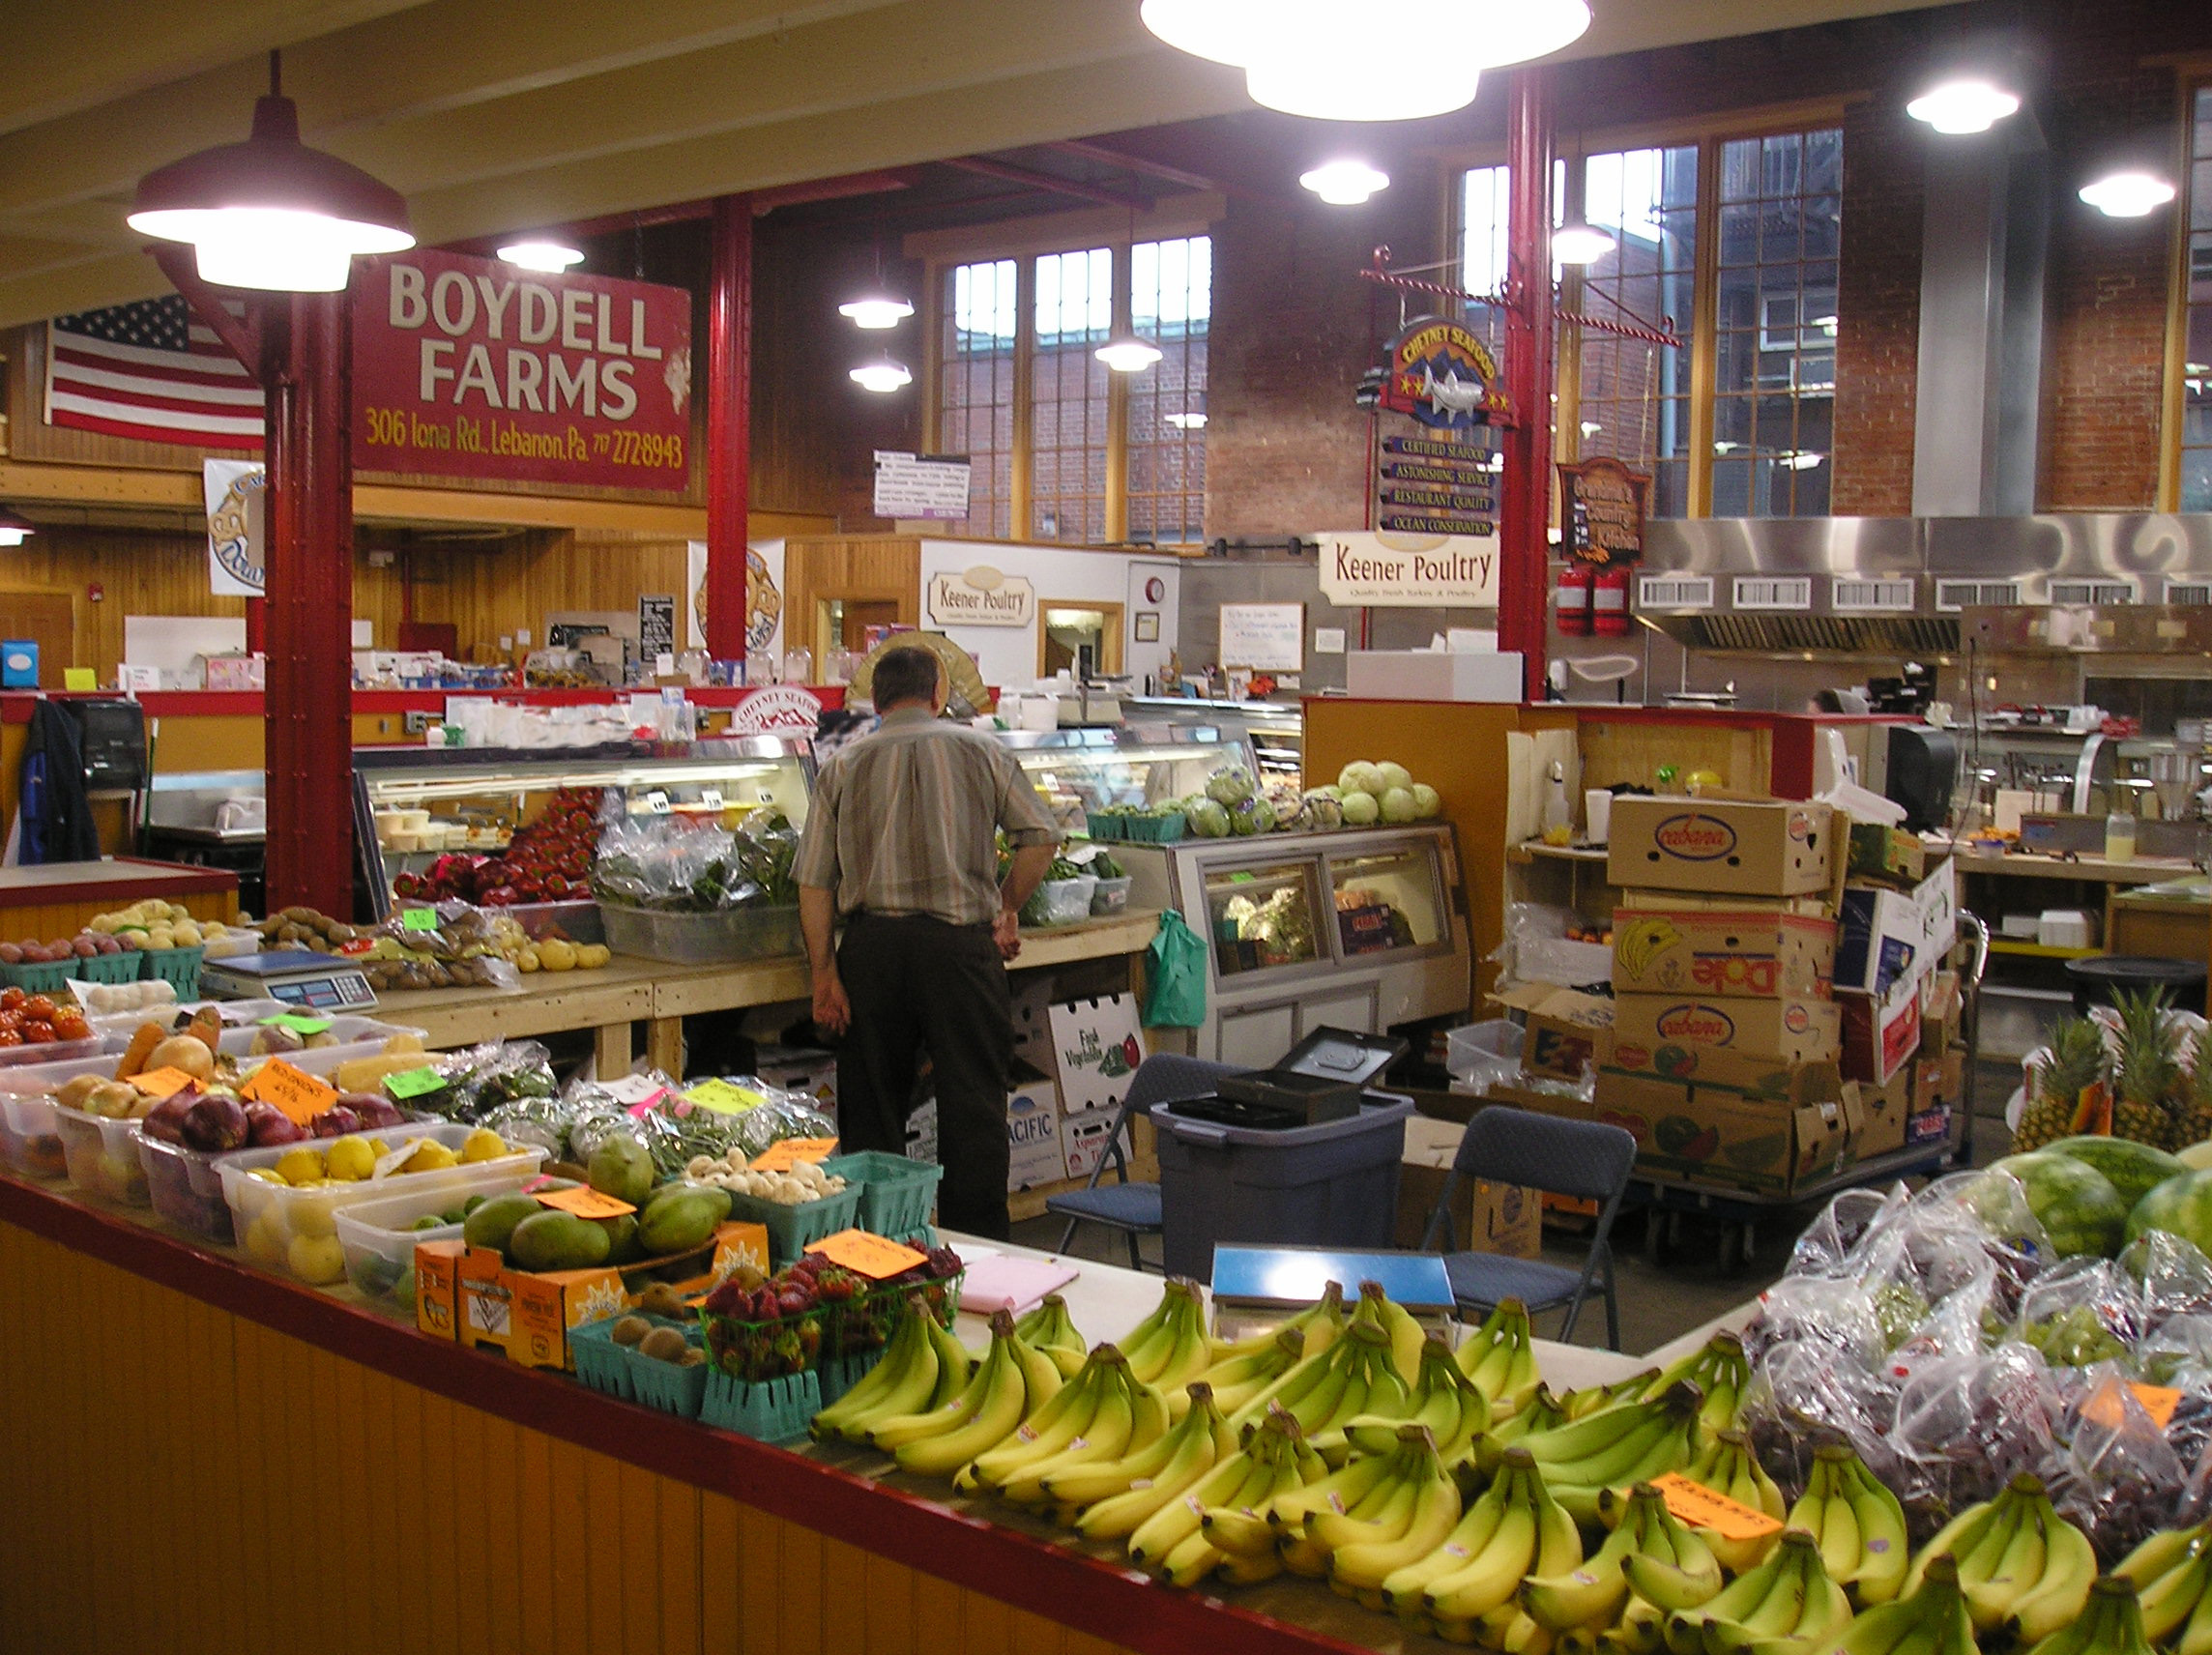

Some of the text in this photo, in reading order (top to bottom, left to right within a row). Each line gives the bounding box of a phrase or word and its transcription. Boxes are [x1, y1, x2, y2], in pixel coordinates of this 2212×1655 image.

[389, 263, 662, 361] BOYDELL
[1402, 324, 1496, 380] CHEYNEY SEAFOOD
[420, 338, 638, 421] FARMS
[365, 406, 406, 449] 306
[412, 411, 451, 451] Iona
[612, 428, 683, 469] 2728943
[1402, 440, 1486, 461] CERTIFIED SEAFOOD
[1396, 464, 1489, 487] ASTONISHING SERVICE
[1394, 488, 1489, 511] RESTAURANT QUALITY
[1394, 516, 1490, 535] OCEAN CONSERVATION
[1336, 541, 1492, 589] Keener Poultry
[941, 578, 1025, 616] Keener Poultry
[739, 691, 778, 723] CHEYNEY
[1692, 956, 1776, 994] Dole
[1009, 1114, 1052, 1143] ACIFIC
